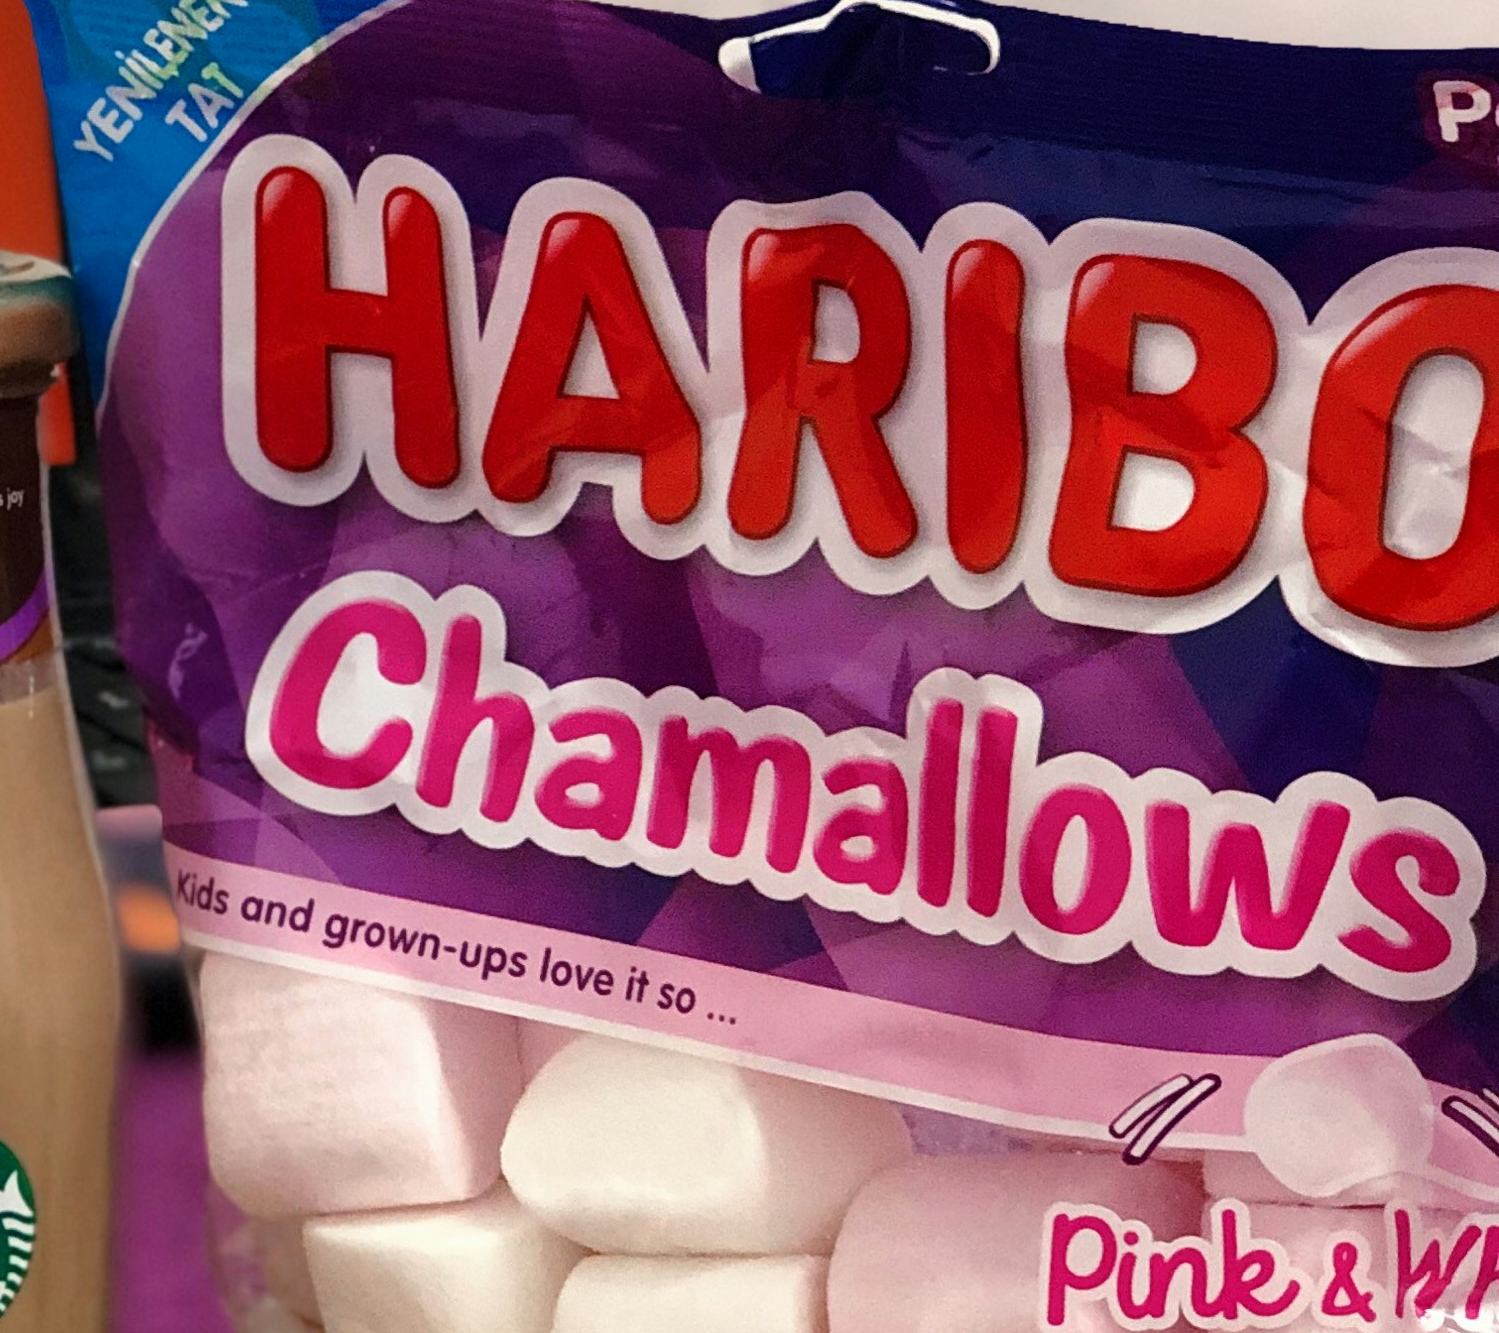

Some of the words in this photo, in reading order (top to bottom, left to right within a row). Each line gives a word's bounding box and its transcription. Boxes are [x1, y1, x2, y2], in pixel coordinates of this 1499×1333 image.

[165, 62, 244, 142] TAT
[1433, 80, 1499, 141] P
[253, 164, 1499, 631] HARIBO
[6, 487, 25, 511] joy
[269, 597, 1462, 974] Chamallows
[176, 869, 230, 914] Kids
[240, 898, 314, 932] and
[322, 913, 527, 980] grown-ups
[540, 947, 614, 995] love
[625, 966, 649, 1003] it
[657, 983, 696, 1014] so
[1047, 1208, 1300, 1326] Pink
[1321, 1242, 1376, 1323] &
